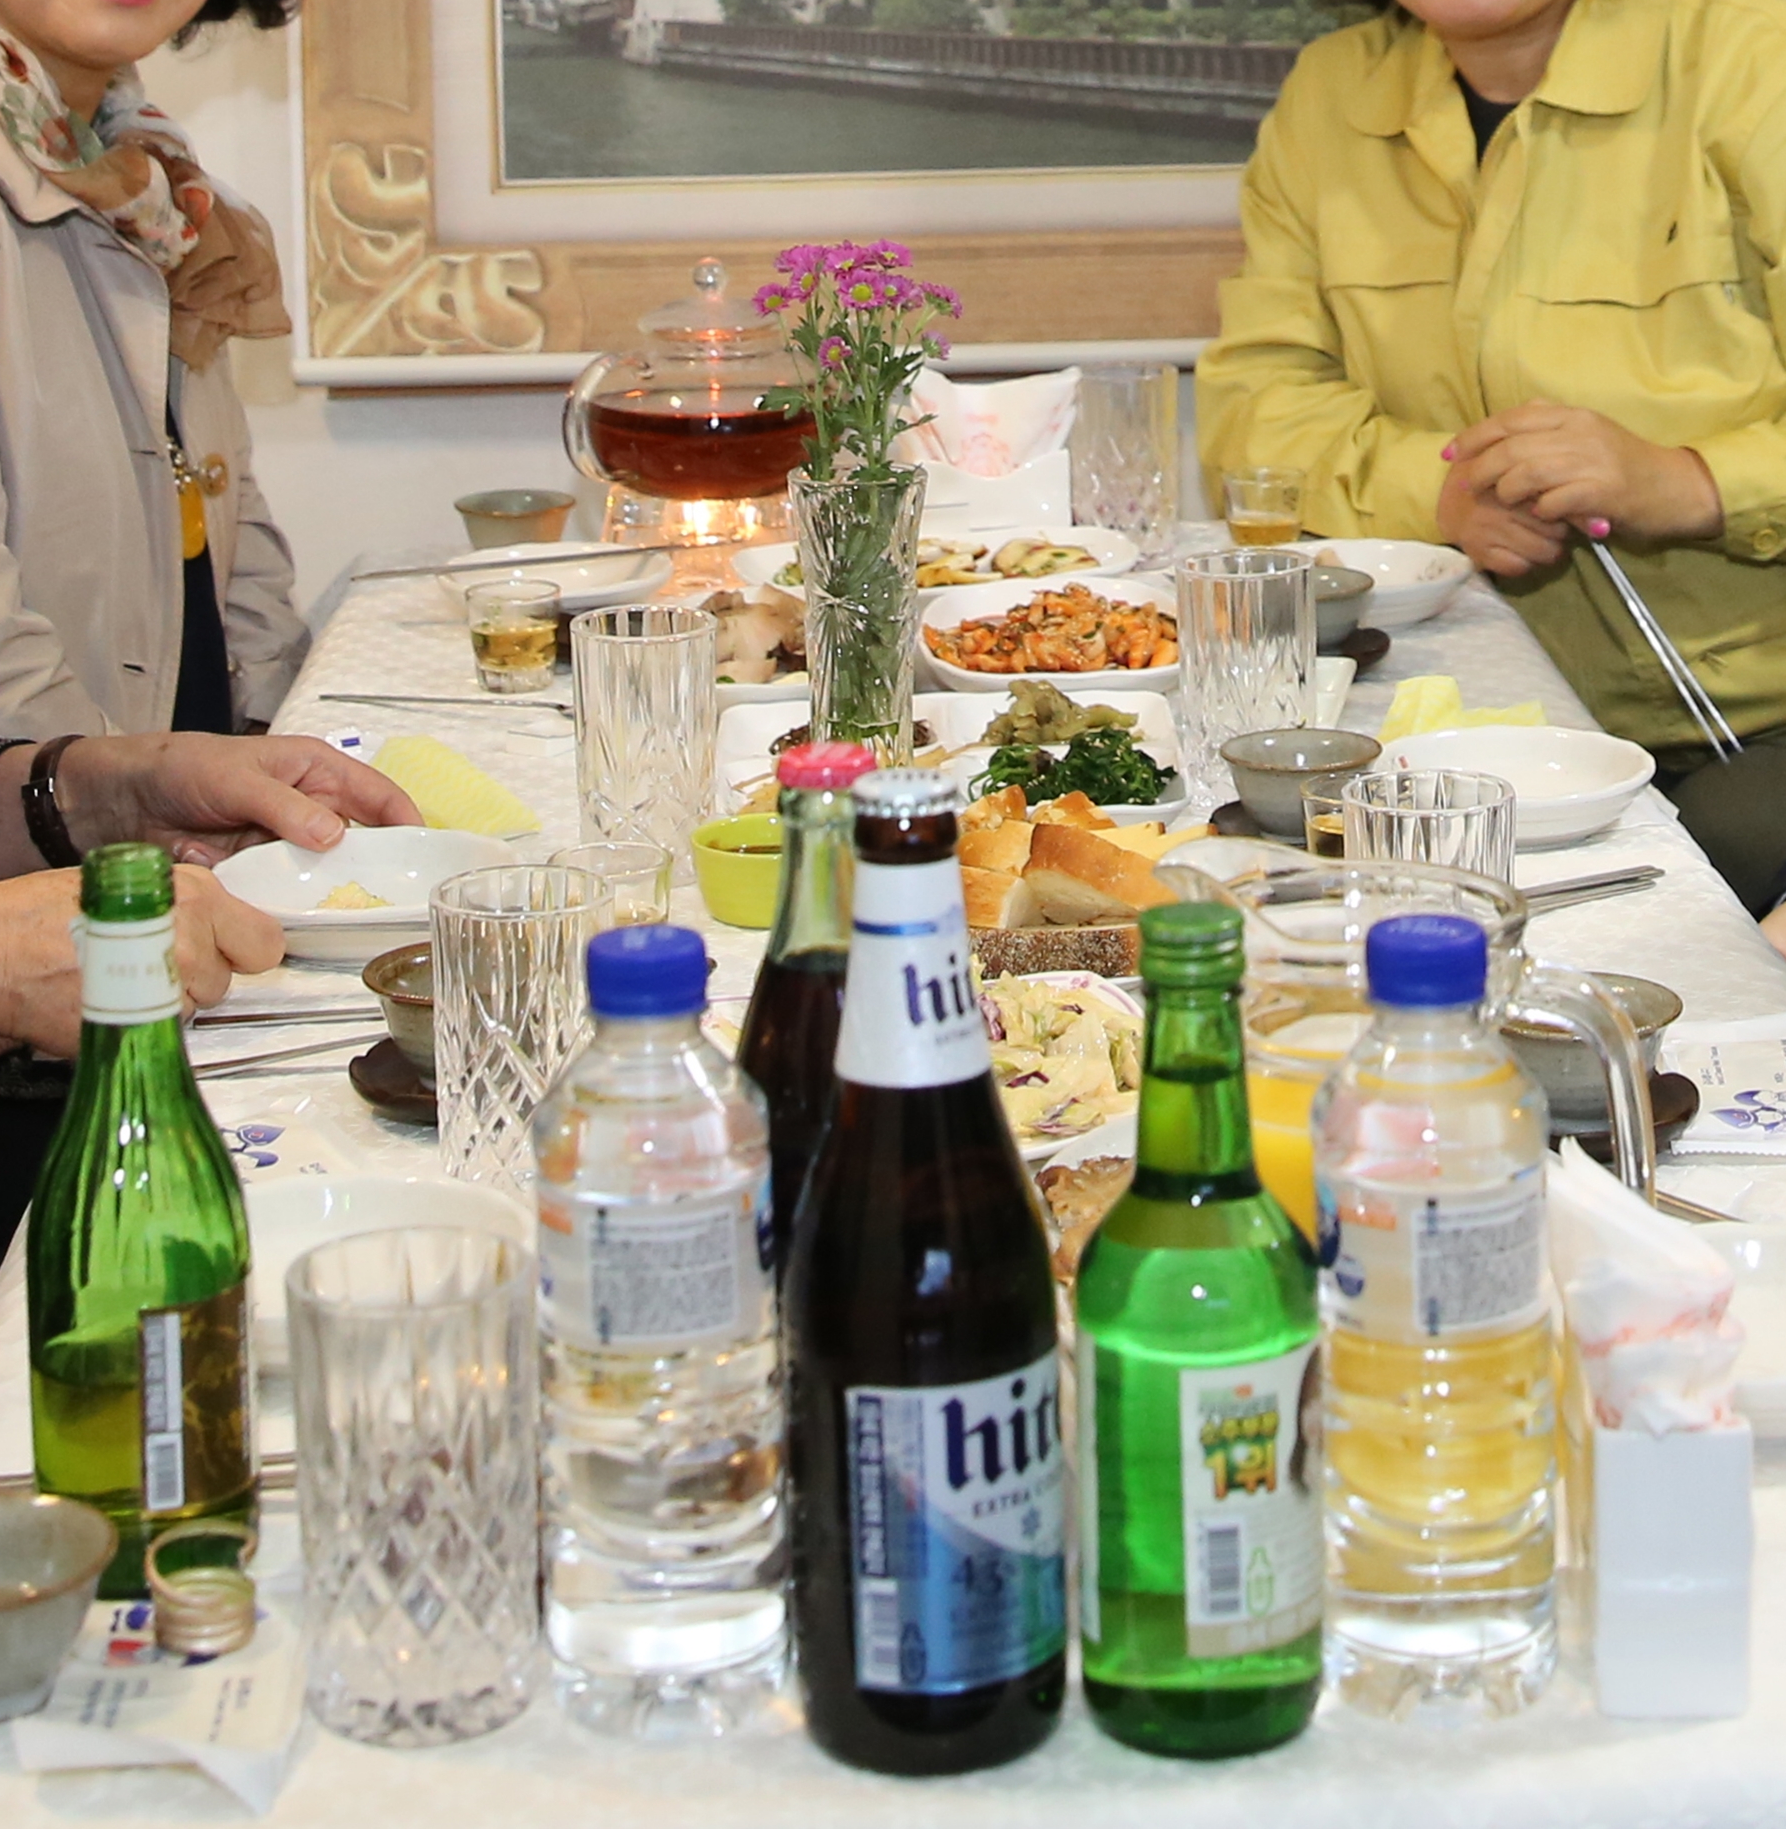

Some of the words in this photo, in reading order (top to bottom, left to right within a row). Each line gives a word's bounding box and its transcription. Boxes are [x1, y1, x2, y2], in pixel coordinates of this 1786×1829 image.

[903, 953, 976, 1027] hit
[943, 1377, 1059, 1491] hit
[972, 1490, 1031, 1519] EXTRA
